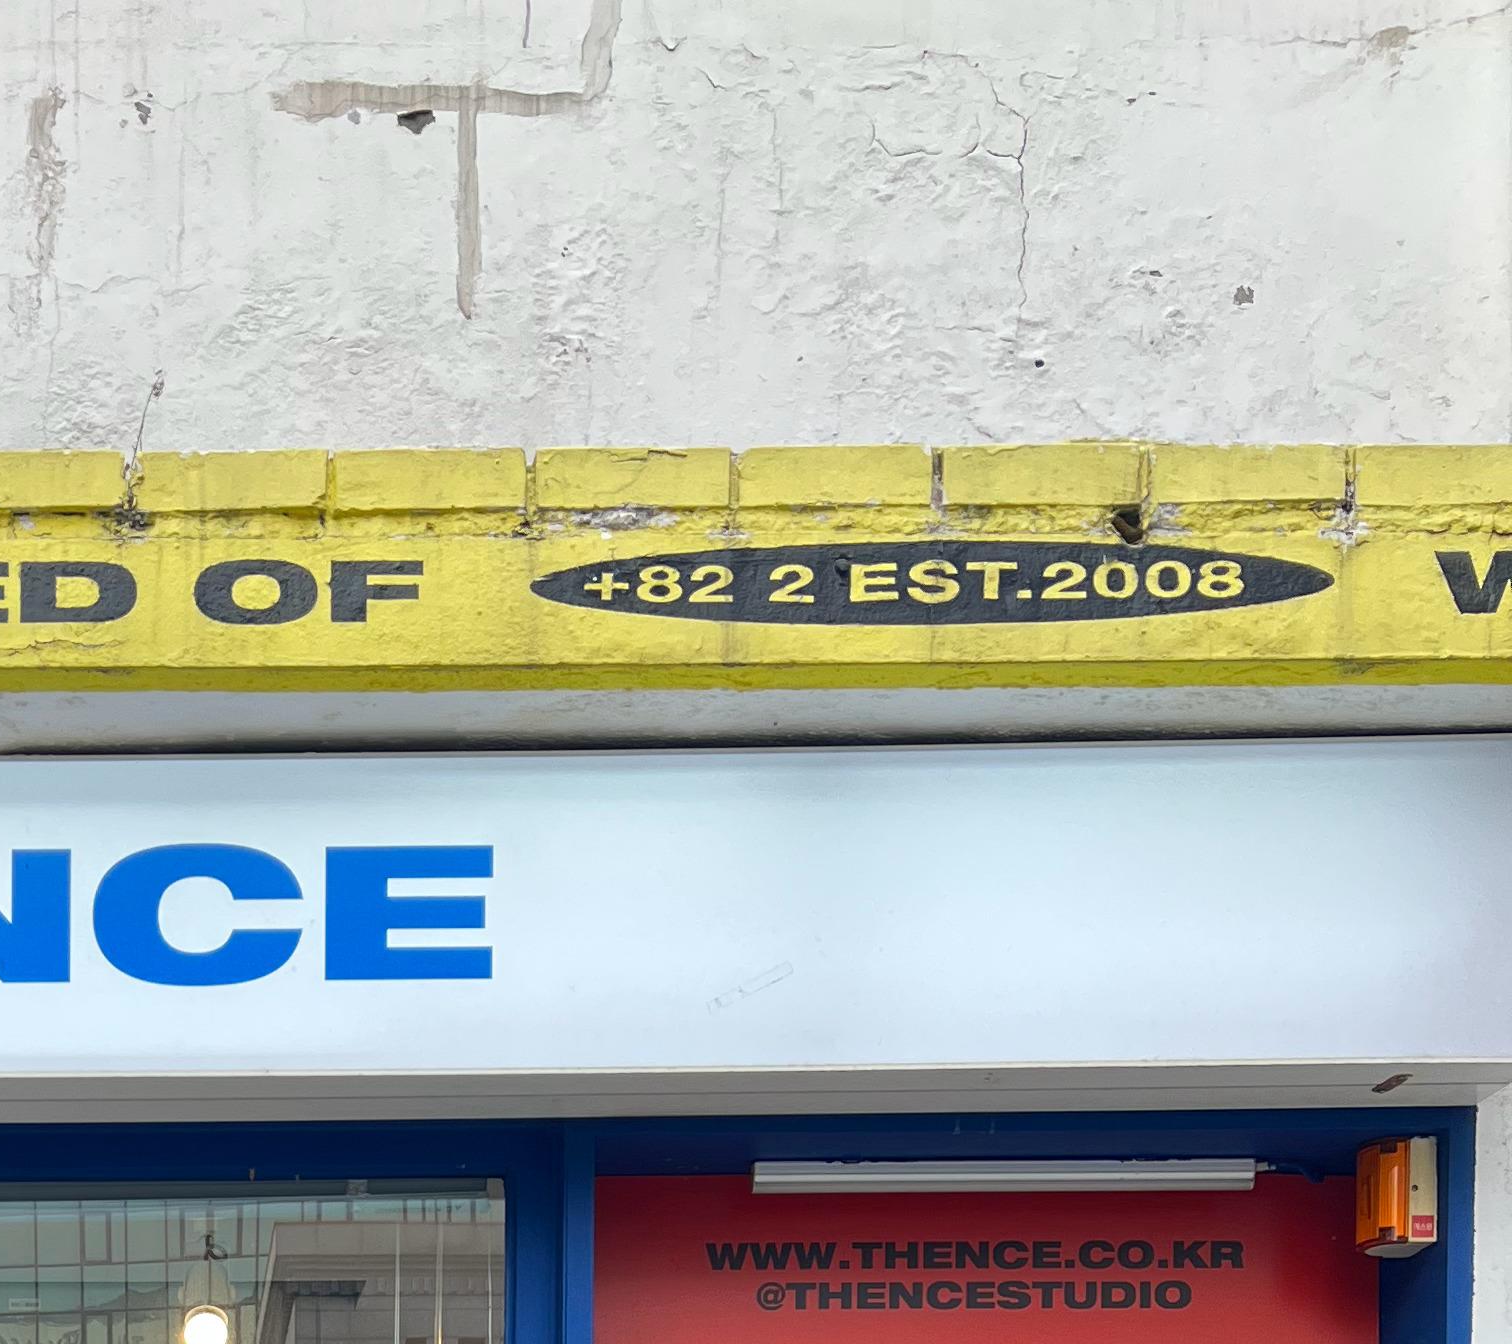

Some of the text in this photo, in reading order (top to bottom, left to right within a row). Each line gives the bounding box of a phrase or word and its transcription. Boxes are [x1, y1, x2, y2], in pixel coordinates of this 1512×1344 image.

[193, 558, 424, 625] OF
[584, 562, 734, 603] +82
[769, 564, 815, 602] 2
[849, 558, 1245, 602] EST.2008
[705, 1239, 1245, 1272] WWW.THENCE.CO.KR
[756, 1280, 1193, 1312] @THENCESTUDIO
